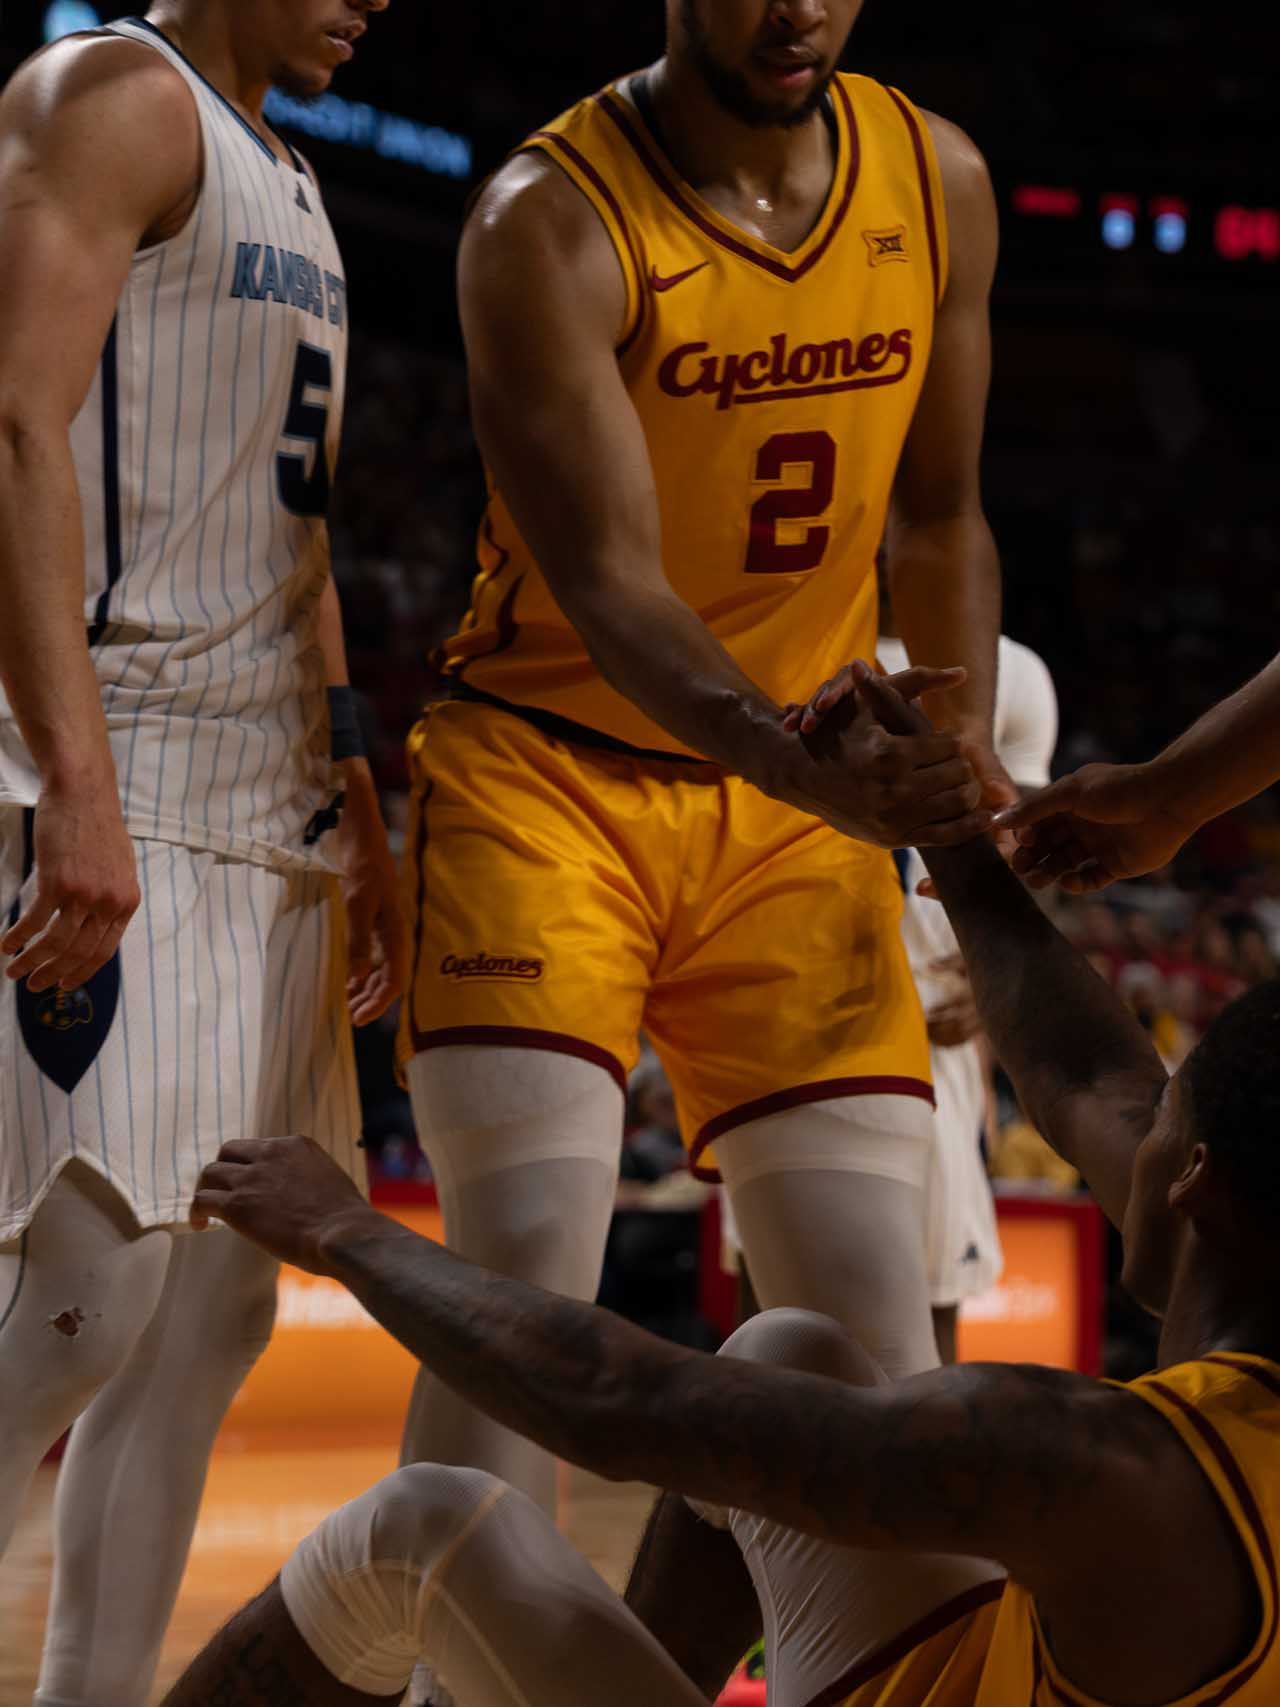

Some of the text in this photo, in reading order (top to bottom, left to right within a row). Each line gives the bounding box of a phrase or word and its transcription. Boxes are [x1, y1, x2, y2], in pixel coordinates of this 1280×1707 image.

[230, 242, 323, 319] KANSAS
[658, 328, 912, 411] Cyclones
[277, 339, 332, 515] 5
[744, 430, 837, 574] 2
[440, 952, 543, 979] Cyclones
